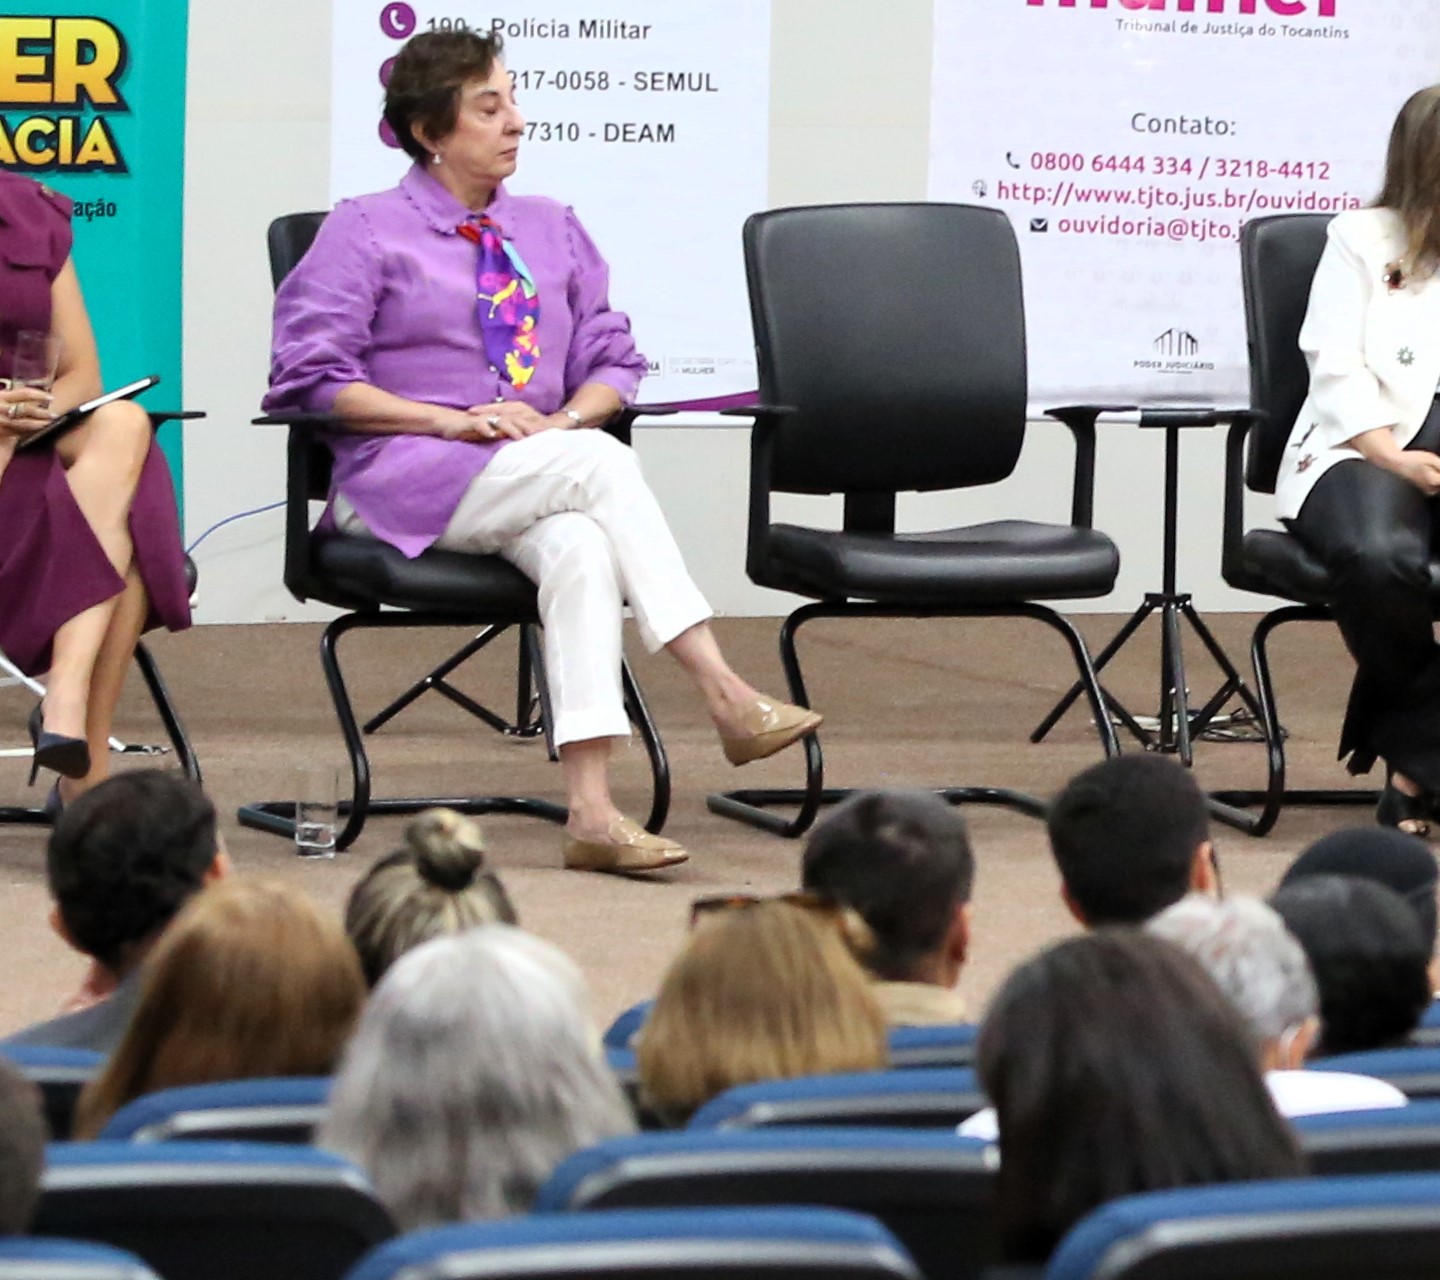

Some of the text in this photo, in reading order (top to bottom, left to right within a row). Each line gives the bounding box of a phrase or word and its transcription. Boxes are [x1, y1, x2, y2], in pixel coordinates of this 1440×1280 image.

[491, 18, 570, 38] Polícia
[578, 20, 652, 40] Militar
[1115, 18, 1350, 40] Tribunal de Justiça do Tocantins
[507, 70, 610, 91] 217-0058
[633, 72, 719, 93] SEMUL
[520, 122, 580, 142] 7310
[604, 123, 676, 144] DEAM
[1130, 112, 1237, 137] Contato:
[1029, 151, 1086, 172] 0800
[1091, 153, 1146, 174] 6444
[1152, 155, 1193, 176] 334
[1215, 158, 1331, 181] 3218-4412
[996, 181, 1363, 213] http://www.tjto.jus.br/ouvidoria
[73, 198, 117, 222] ação
[1057, 215, 1244, 242] ouvidoria@tjto.j
